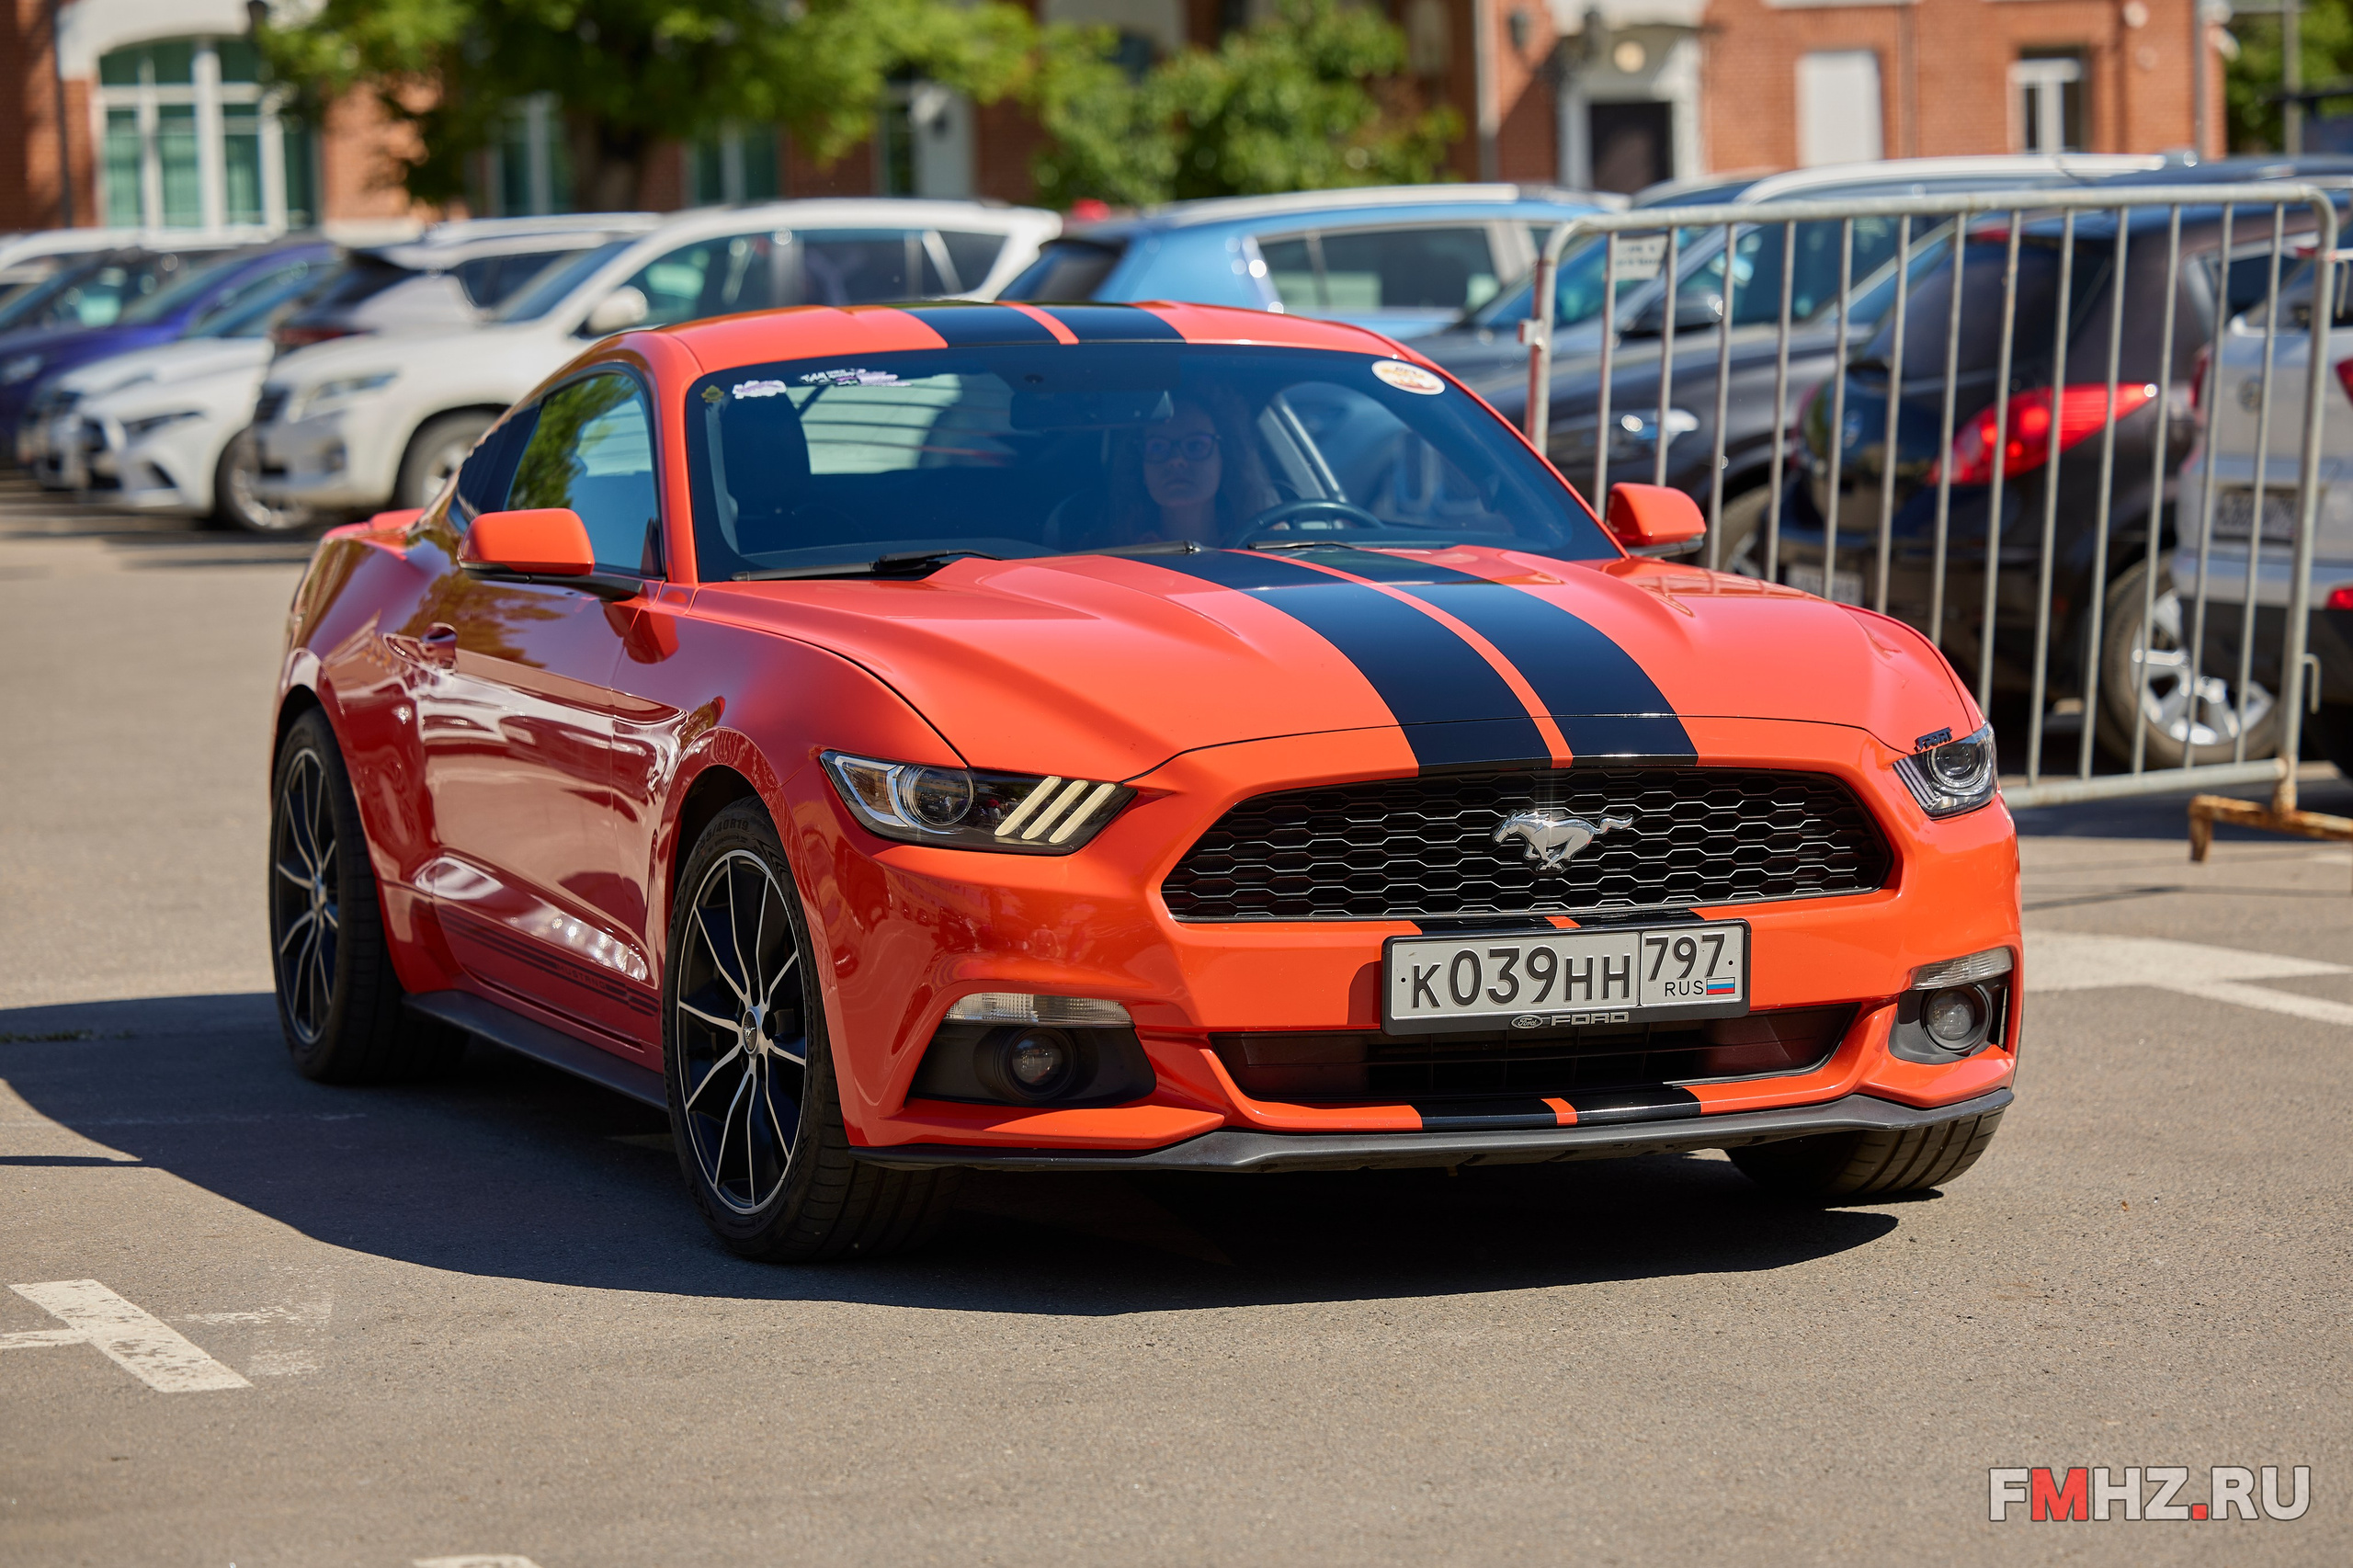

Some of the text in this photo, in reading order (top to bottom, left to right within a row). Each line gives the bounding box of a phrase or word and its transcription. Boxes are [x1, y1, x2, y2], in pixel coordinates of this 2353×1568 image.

[554, 963, 607, 989] MUSTANG
[1411, 933, 1725, 1008] К039НН 797
[1665, 980, 1704, 997] RUS
[1550, 1011, 1630, 1027] FORD
